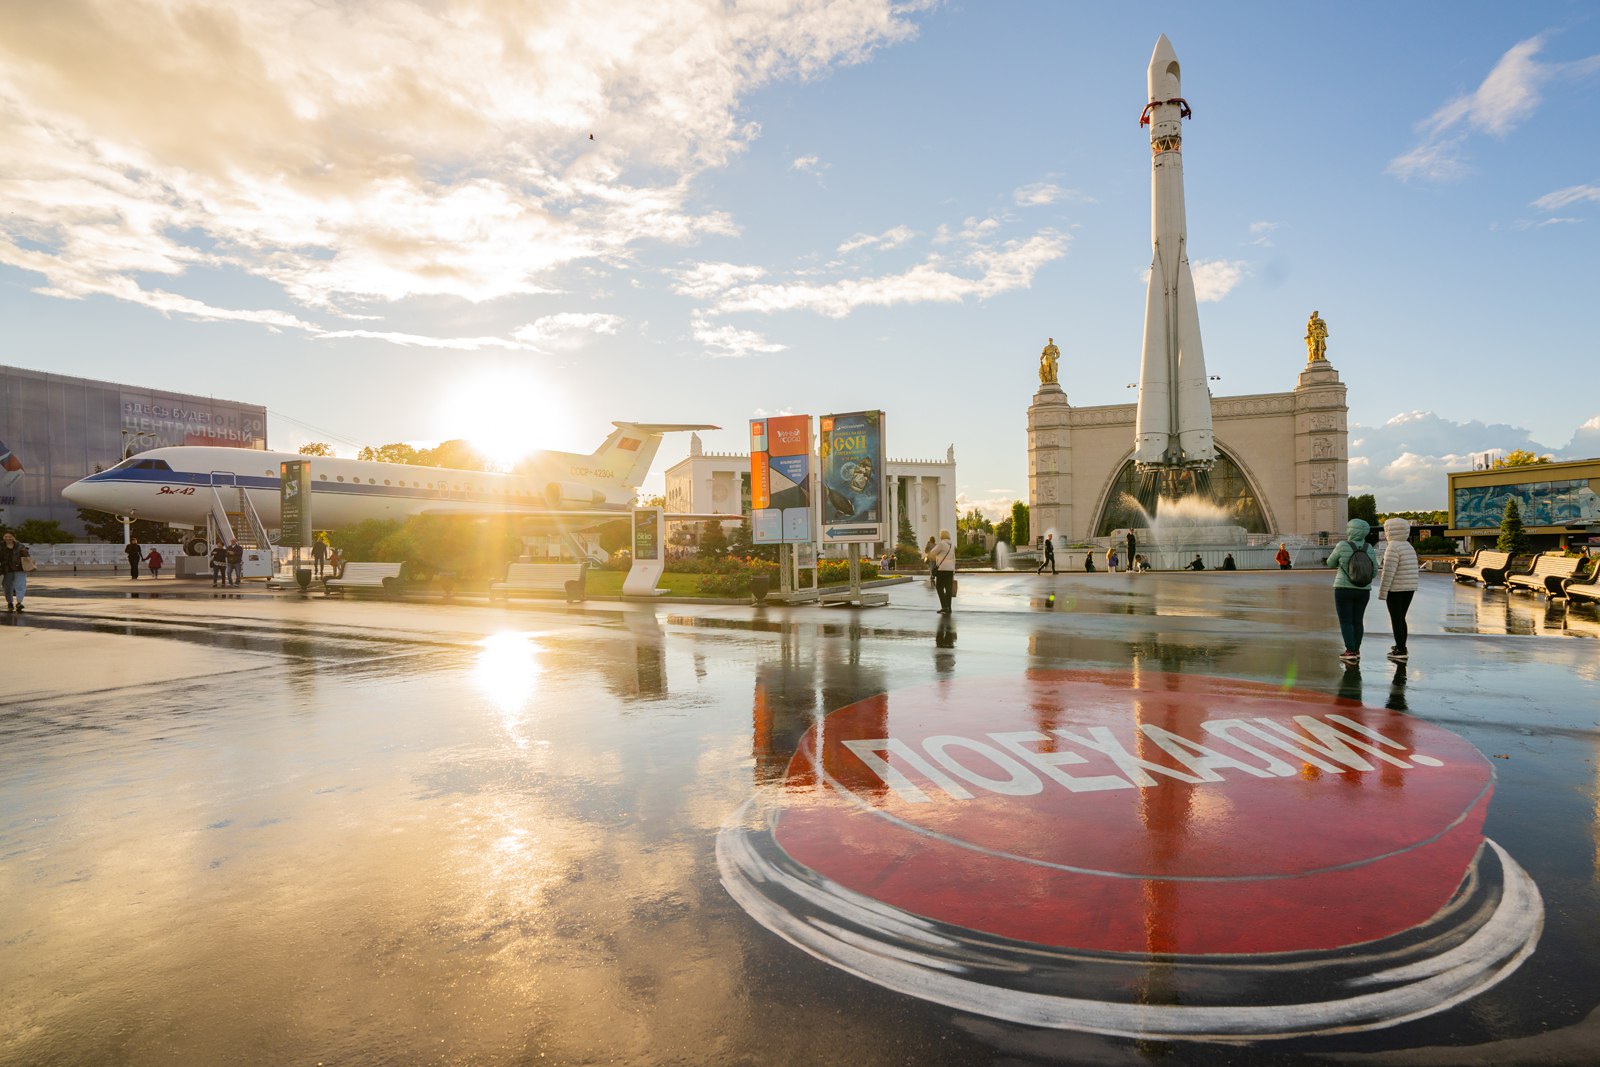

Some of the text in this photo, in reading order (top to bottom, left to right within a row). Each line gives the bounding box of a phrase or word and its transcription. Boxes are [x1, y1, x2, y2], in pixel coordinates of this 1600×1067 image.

[124, 402, 212, 423] ЗДЕСЬ БУДЕТ
[125, 416, 252, 443] ЦЕНТРАЛЬНЫЙ
[833, 435, 867, 451] СОН
[841, 713, 1445, 803] ПОЕХАЛИ!
